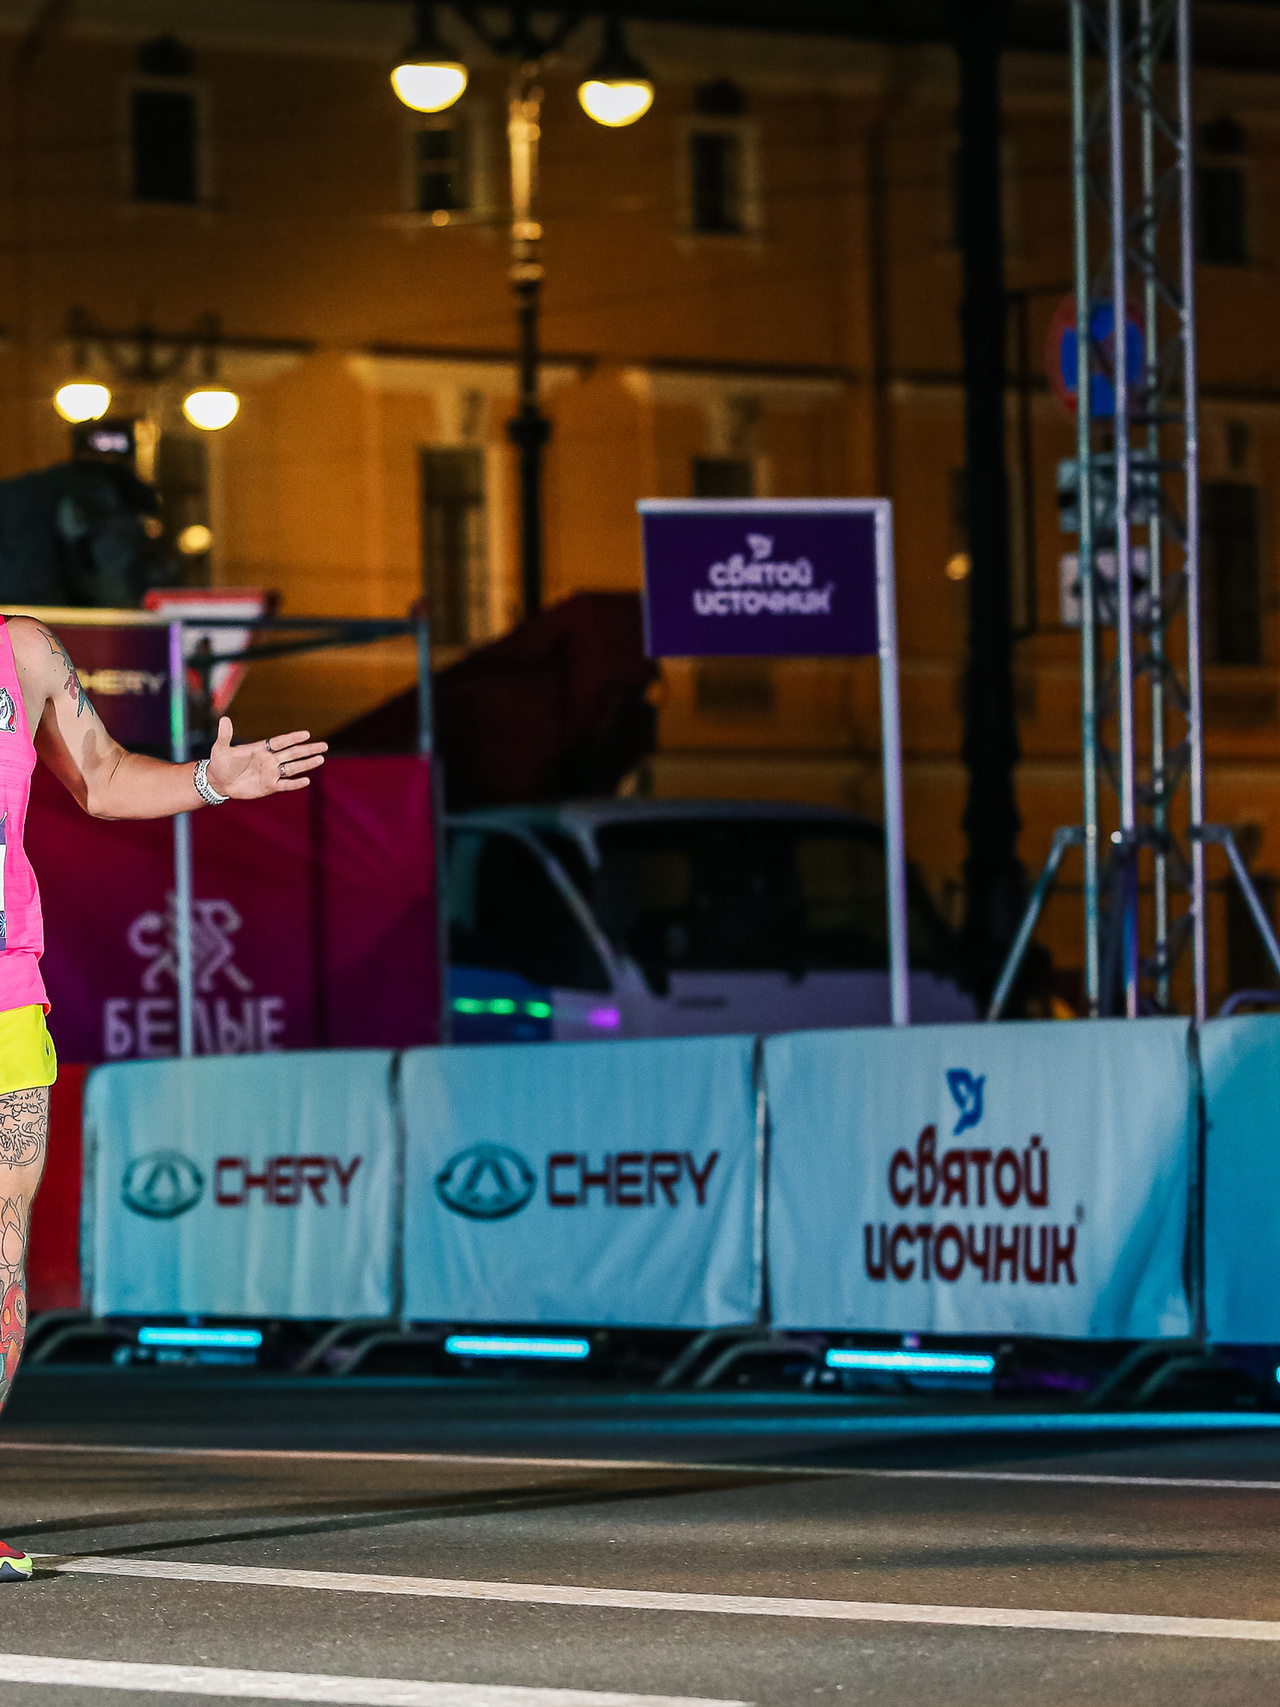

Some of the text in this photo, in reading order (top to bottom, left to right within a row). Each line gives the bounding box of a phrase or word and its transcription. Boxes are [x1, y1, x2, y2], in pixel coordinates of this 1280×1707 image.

[76, 668, 166, 695] HERY
[215, 1154, 362, 1208] CHERY
[546, 1151, 719, 1207] CHERY
